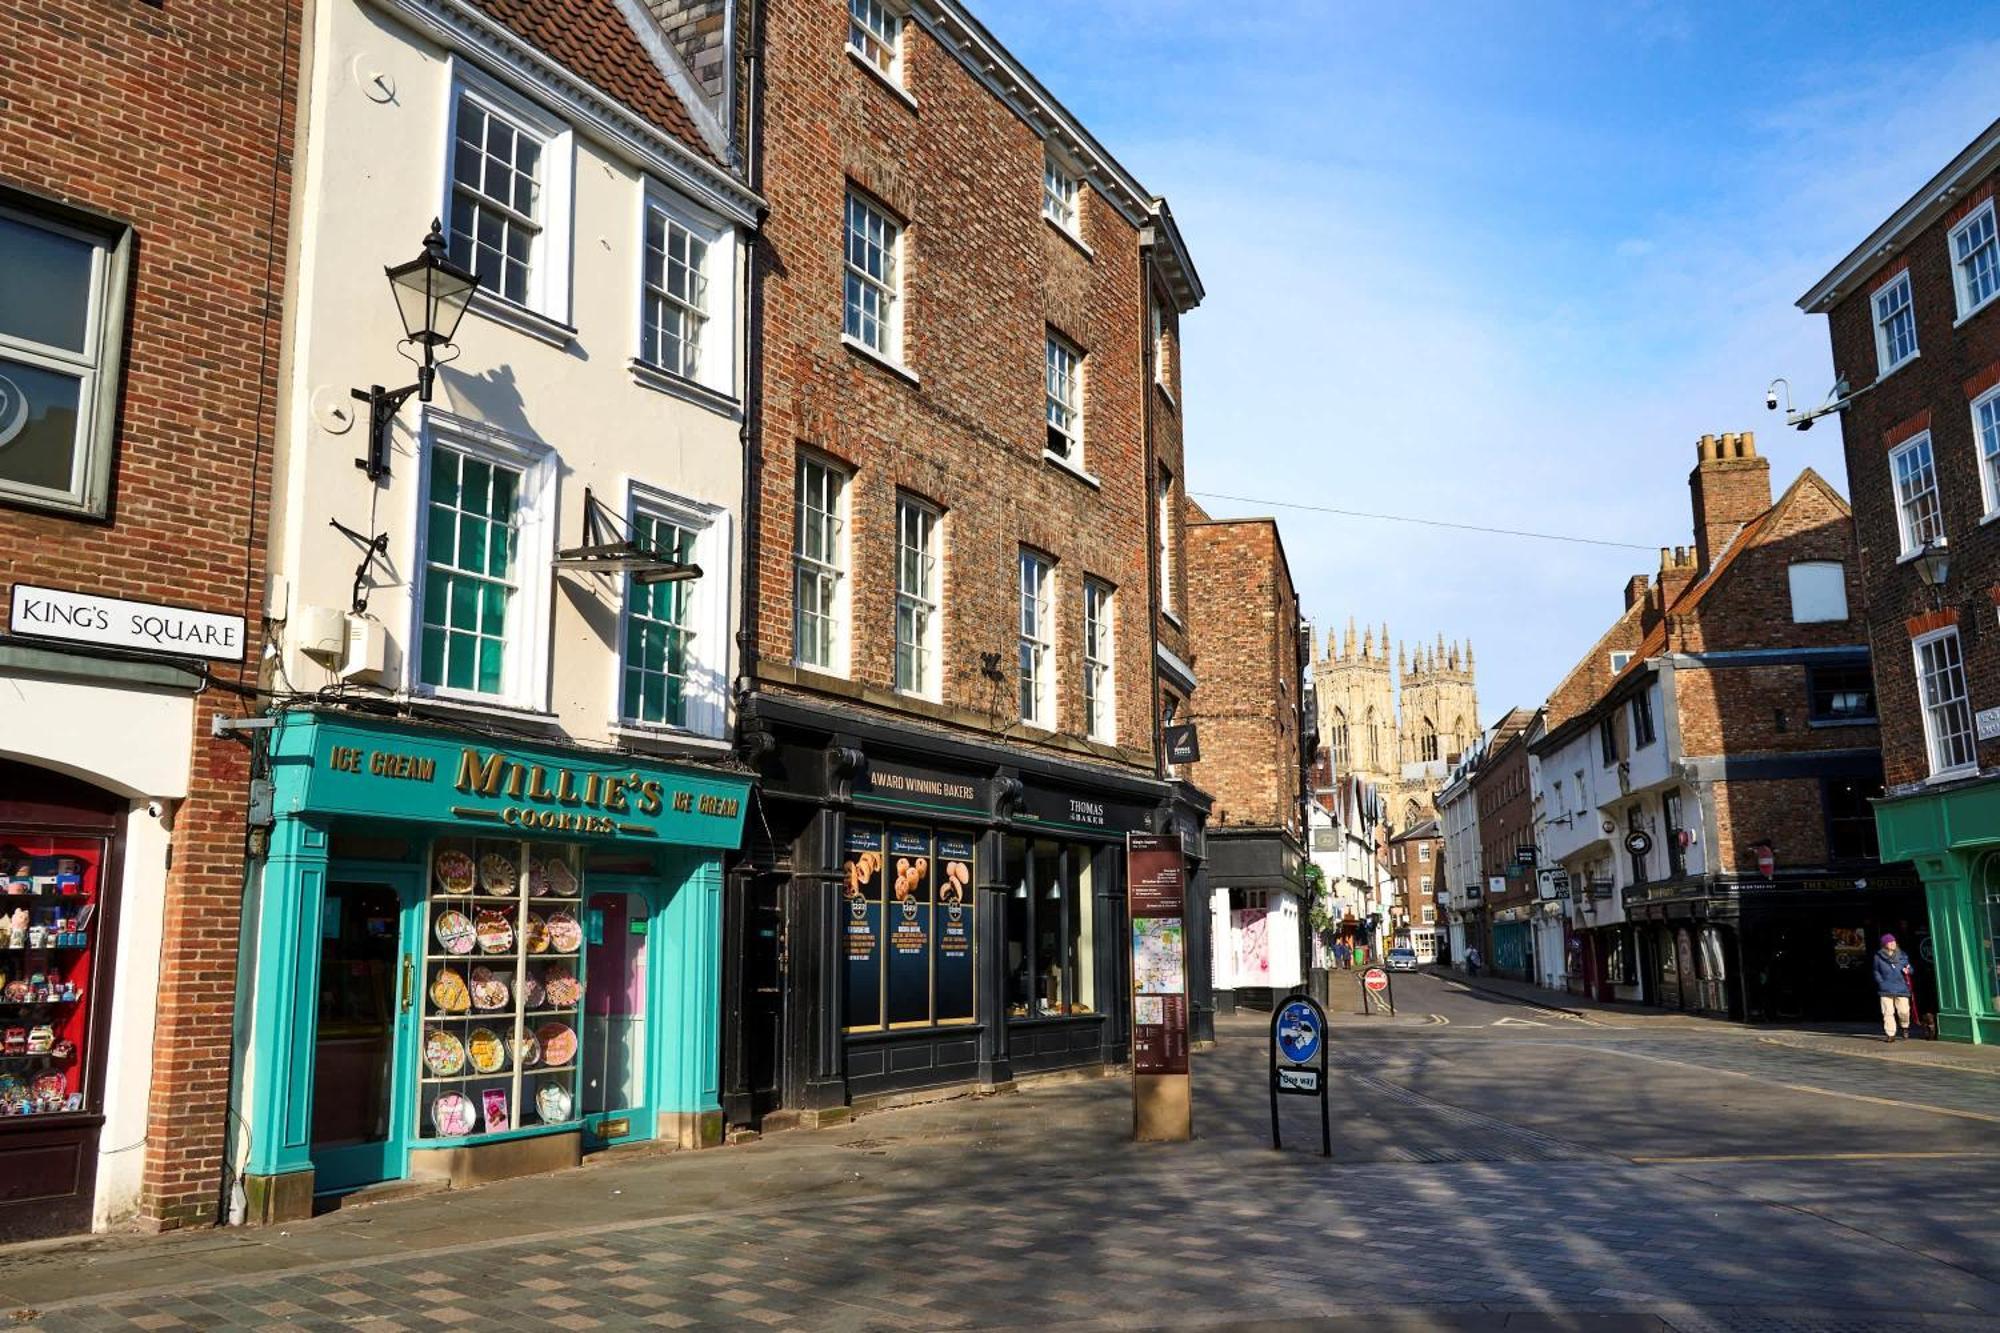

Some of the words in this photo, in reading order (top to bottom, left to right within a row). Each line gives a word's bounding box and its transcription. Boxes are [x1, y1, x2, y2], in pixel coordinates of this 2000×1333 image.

[22, 599, 109, 630] KING'S
[131, 615, 236, 647] SQUARE
[330, 745, 363, 773] ICE
[369, 751, 436, 782] CREAM
[454, 746, 662, 812] MILLIE'S
[870, 771, 904, 790] AWARD
[904, 777, 942, 796] WINNING
[943, 783, 974, 800] BAKERS
[672, 790, 693, 813] ICE
[697, 793, 739, 818] CREAM
[1069, 799, 1104, 816] THOMAS
[503, 806, 614, 833] COOKIES
